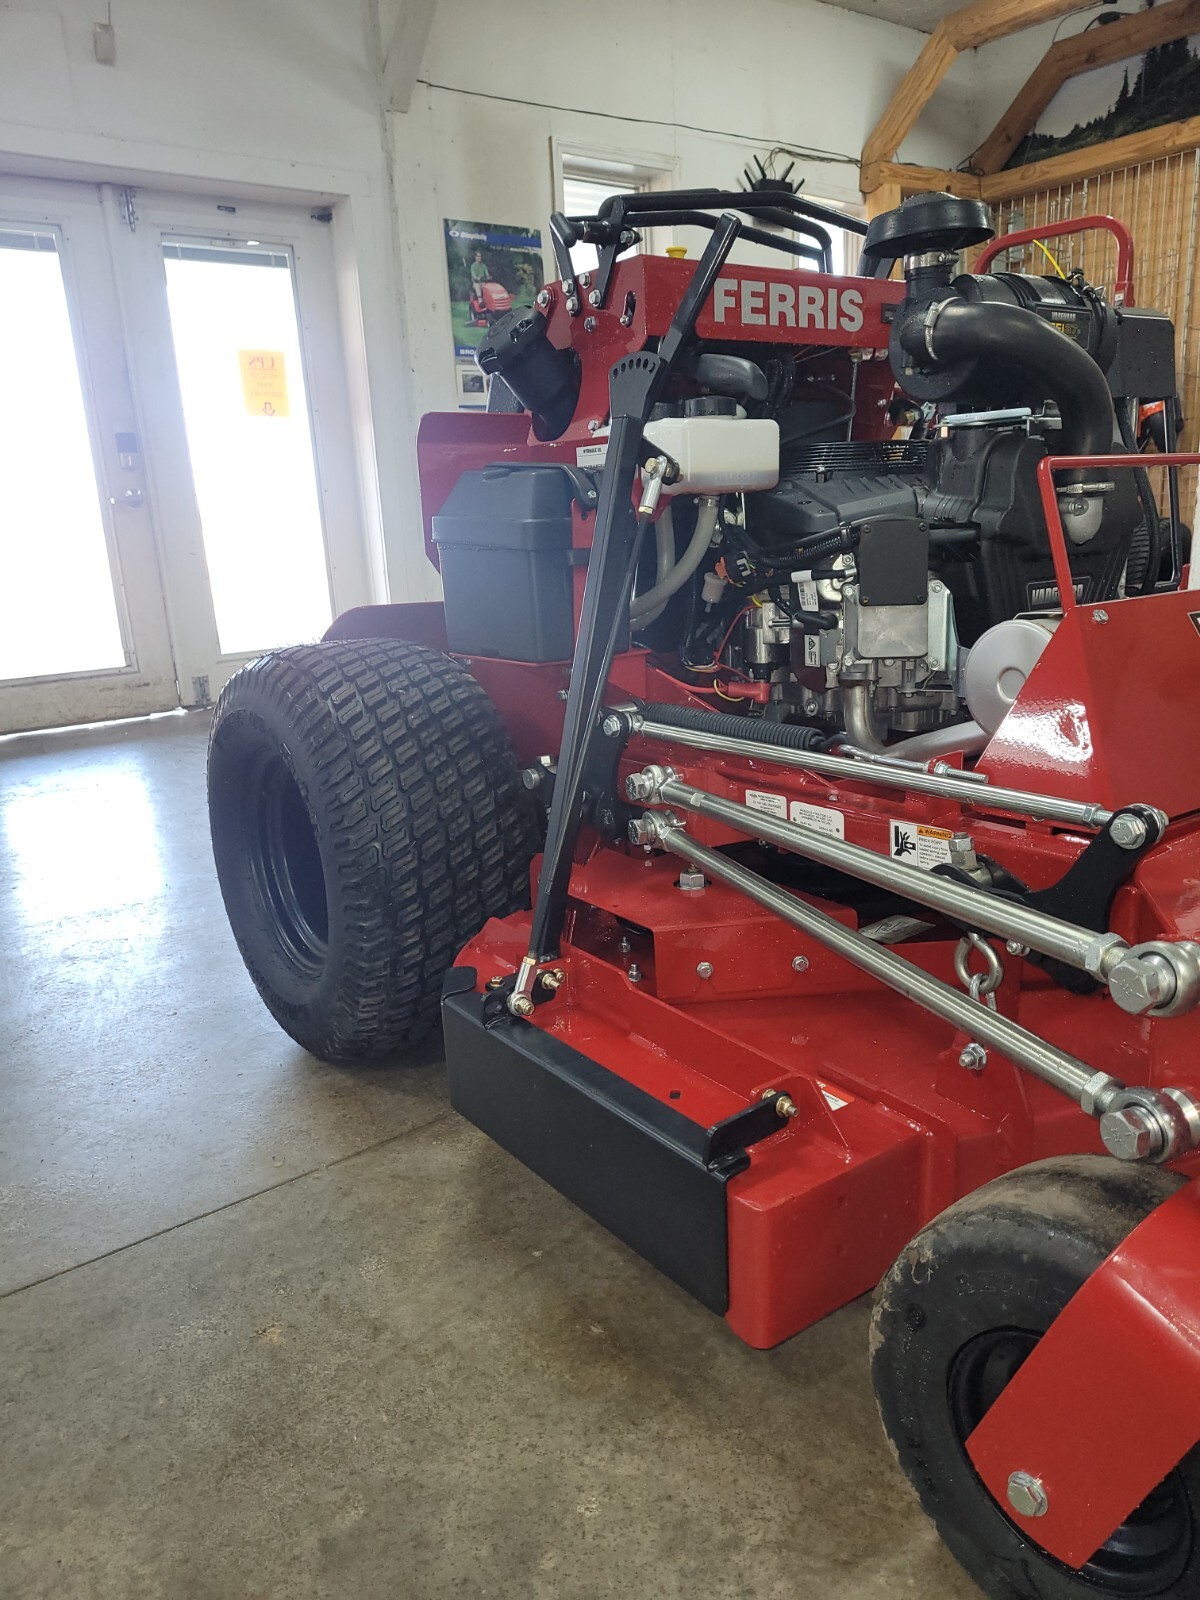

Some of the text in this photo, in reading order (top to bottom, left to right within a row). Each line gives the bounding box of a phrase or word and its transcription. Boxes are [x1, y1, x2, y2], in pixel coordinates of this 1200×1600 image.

[713, 277, 864, 333] FERRIS
[1031, 584, 1084, 606] VANGRD
[925, 830, 952, 839] WARNING
